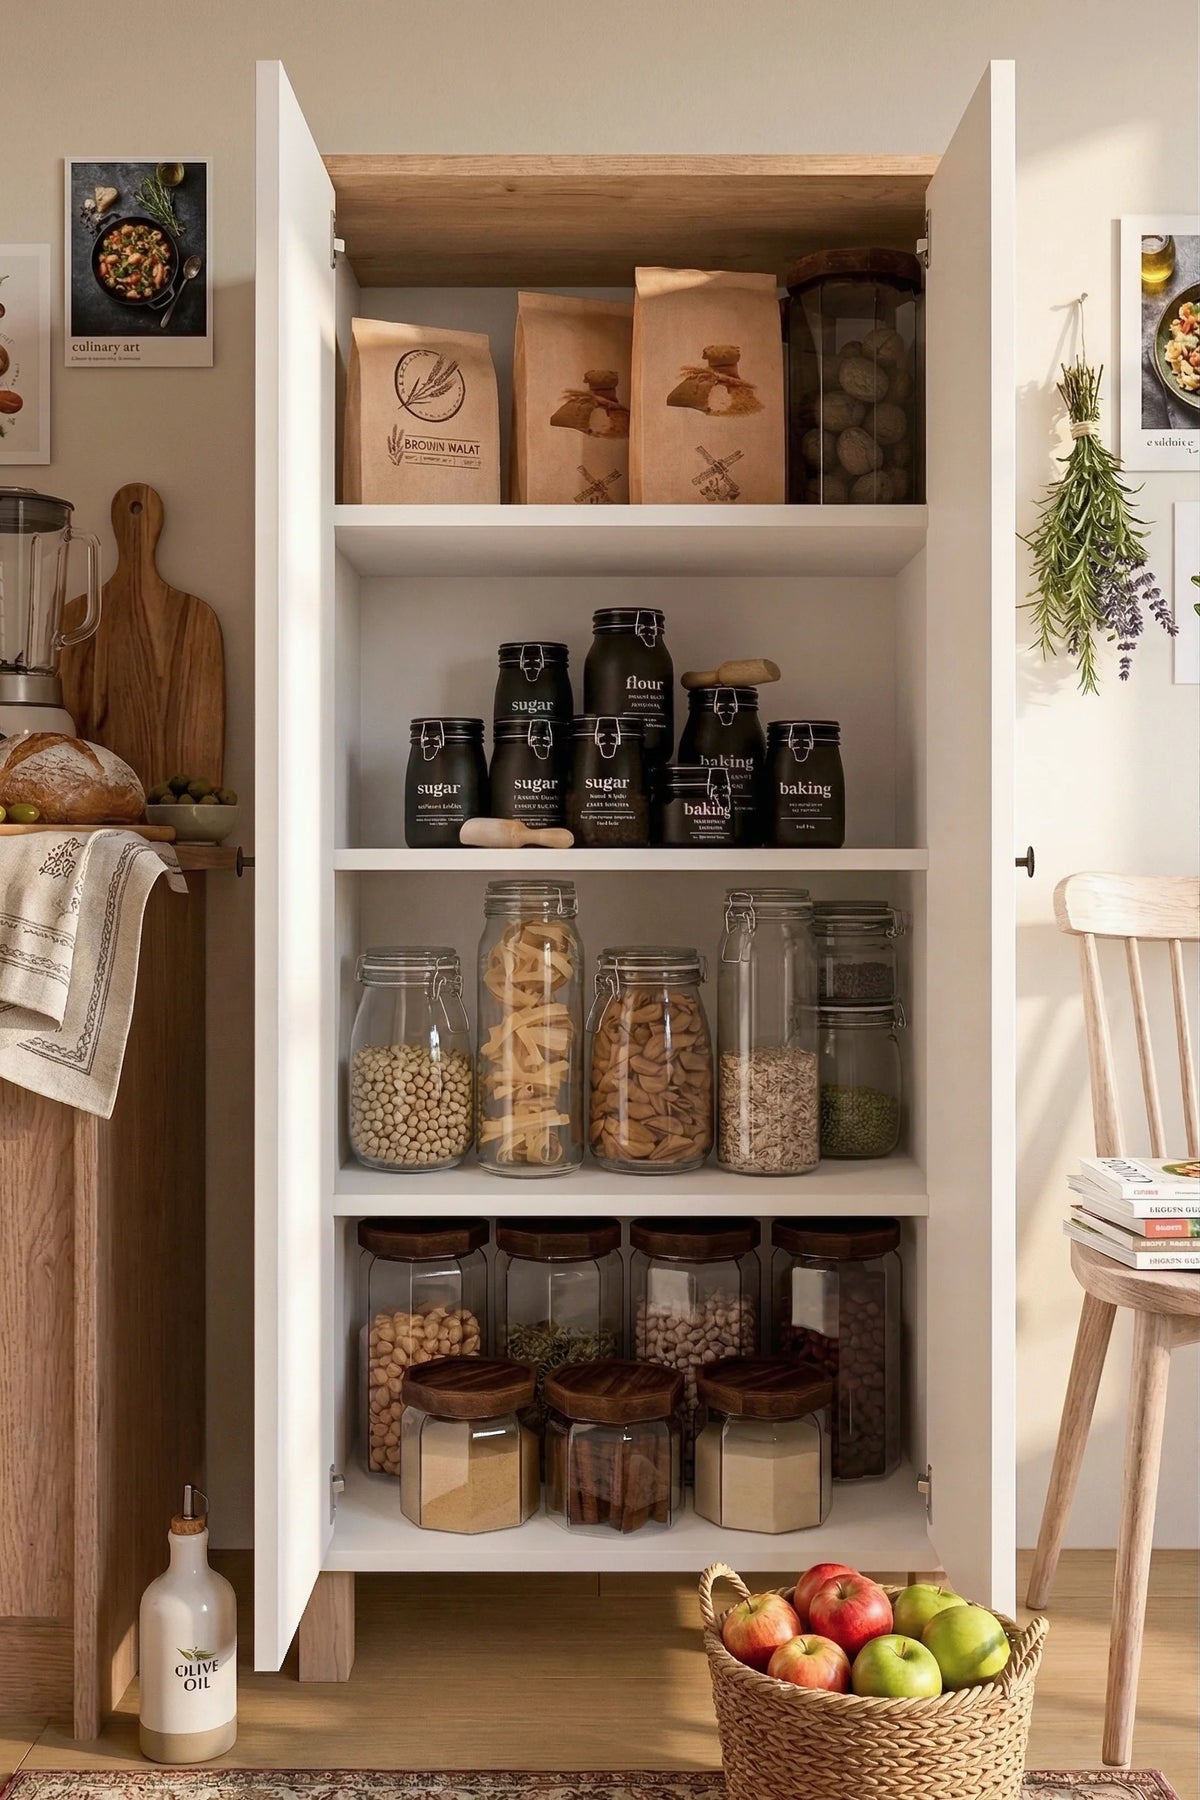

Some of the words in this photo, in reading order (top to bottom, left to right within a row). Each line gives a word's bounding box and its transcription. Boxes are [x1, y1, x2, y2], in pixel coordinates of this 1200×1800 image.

[72, 341, 120, 355] culinary
[123, 344, 140, 352] art
[625, 675, 664, 691] flour
[511, 699, 554, 713] sugar
[700, 754, 754, 771] baking
[417, 783, 461, 798] sugar
[514, 778, 559, 793] sugar
[585, 777, 630, 792] sugar
[779, 781, 832, 799] baking
[684, 802, 731, 819] baking
[175, 1659, 219, 1677] OLIVE
[183, 1676, 211, 1692] OIL
